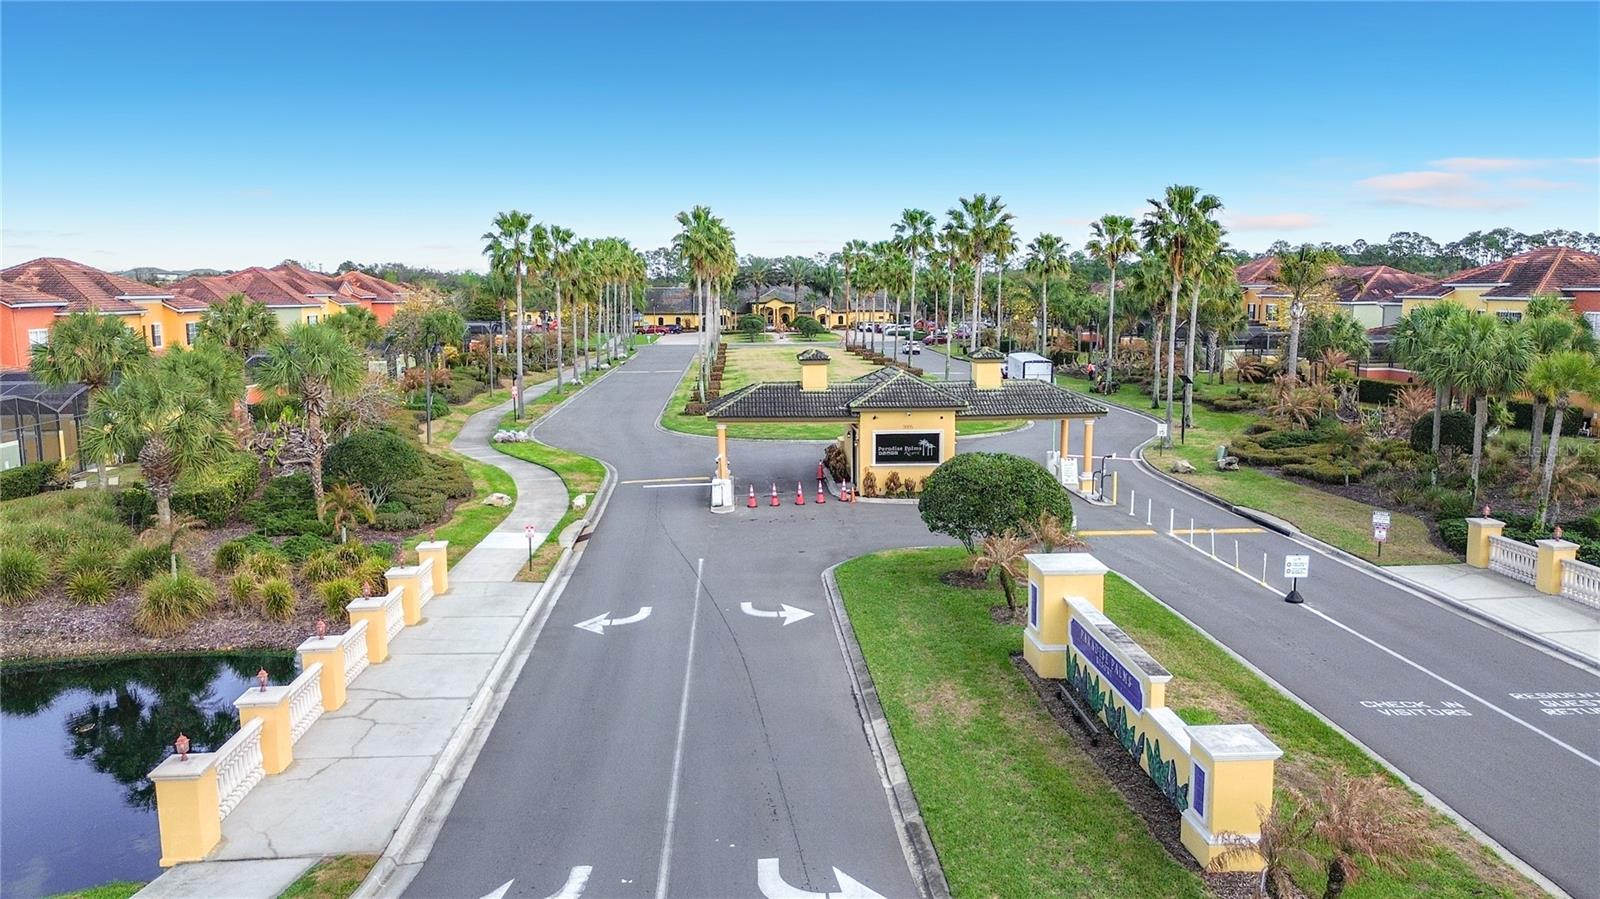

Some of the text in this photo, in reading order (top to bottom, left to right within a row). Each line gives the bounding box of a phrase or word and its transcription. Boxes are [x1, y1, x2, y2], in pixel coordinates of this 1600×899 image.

[1081, 629, 1133, 688] PARADISE PALMS
[1359, 700, 1465, 708] CHECK IN
[1376, 708, 1473, 716] VISITORS
